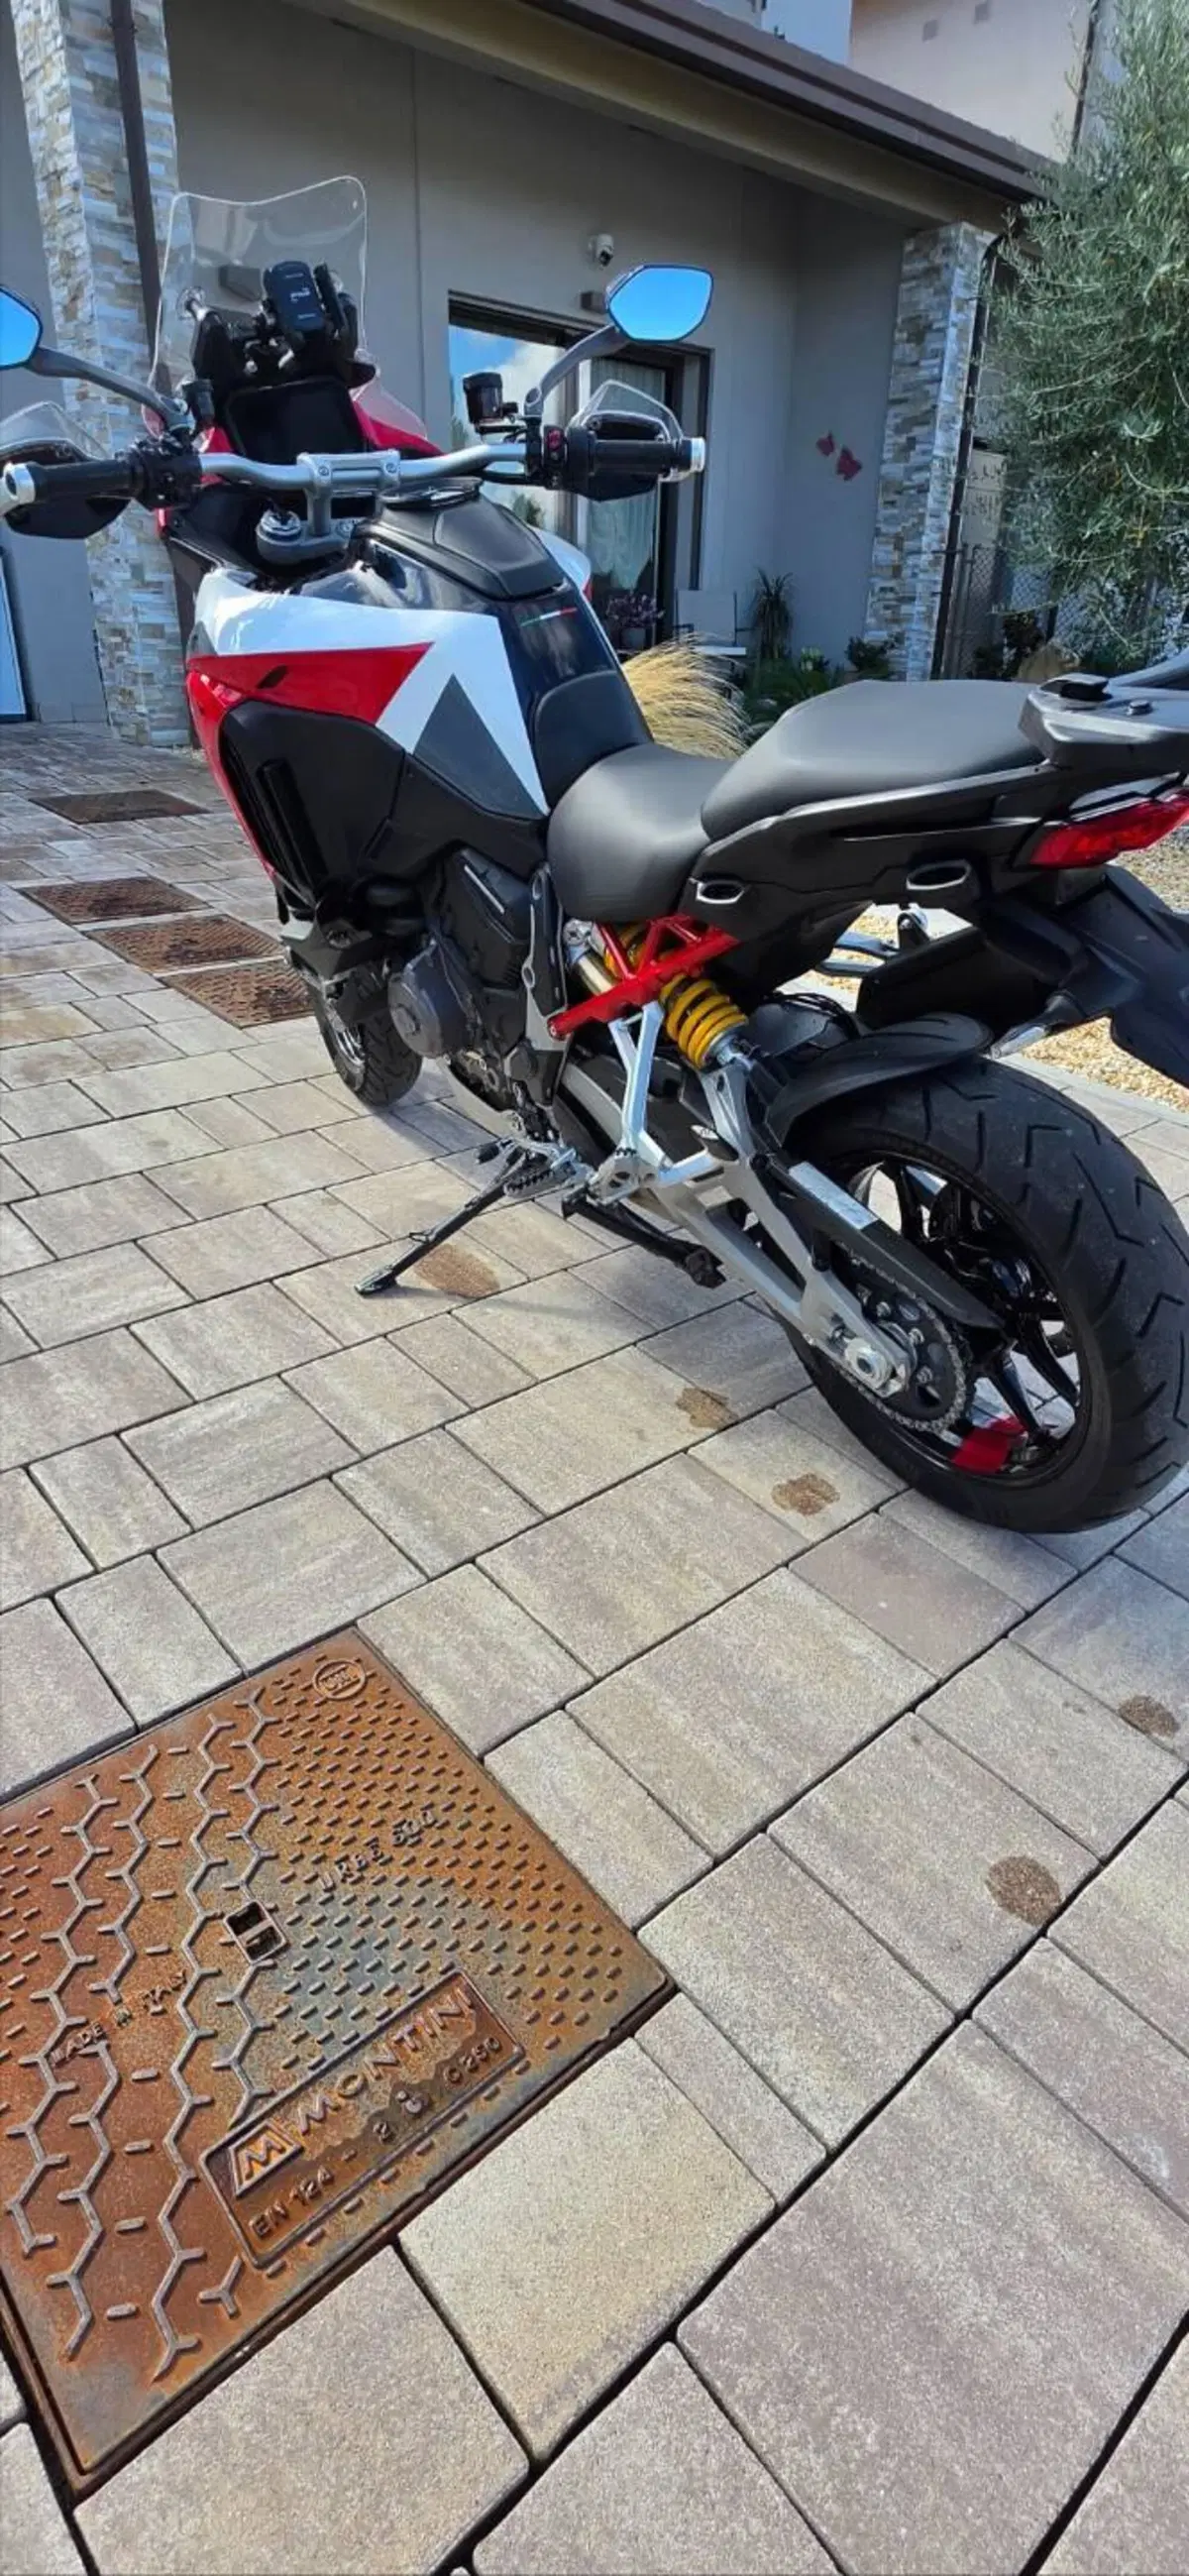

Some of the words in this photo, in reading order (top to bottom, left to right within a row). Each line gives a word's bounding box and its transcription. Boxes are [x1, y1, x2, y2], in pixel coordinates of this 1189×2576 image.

[50, 2023, 107, 2067] MADE
[299, 1987, 474, 2136] MONTINI
[249, 2200, 289, 2239] EN
[288, 2165, 335, 2205] 124
